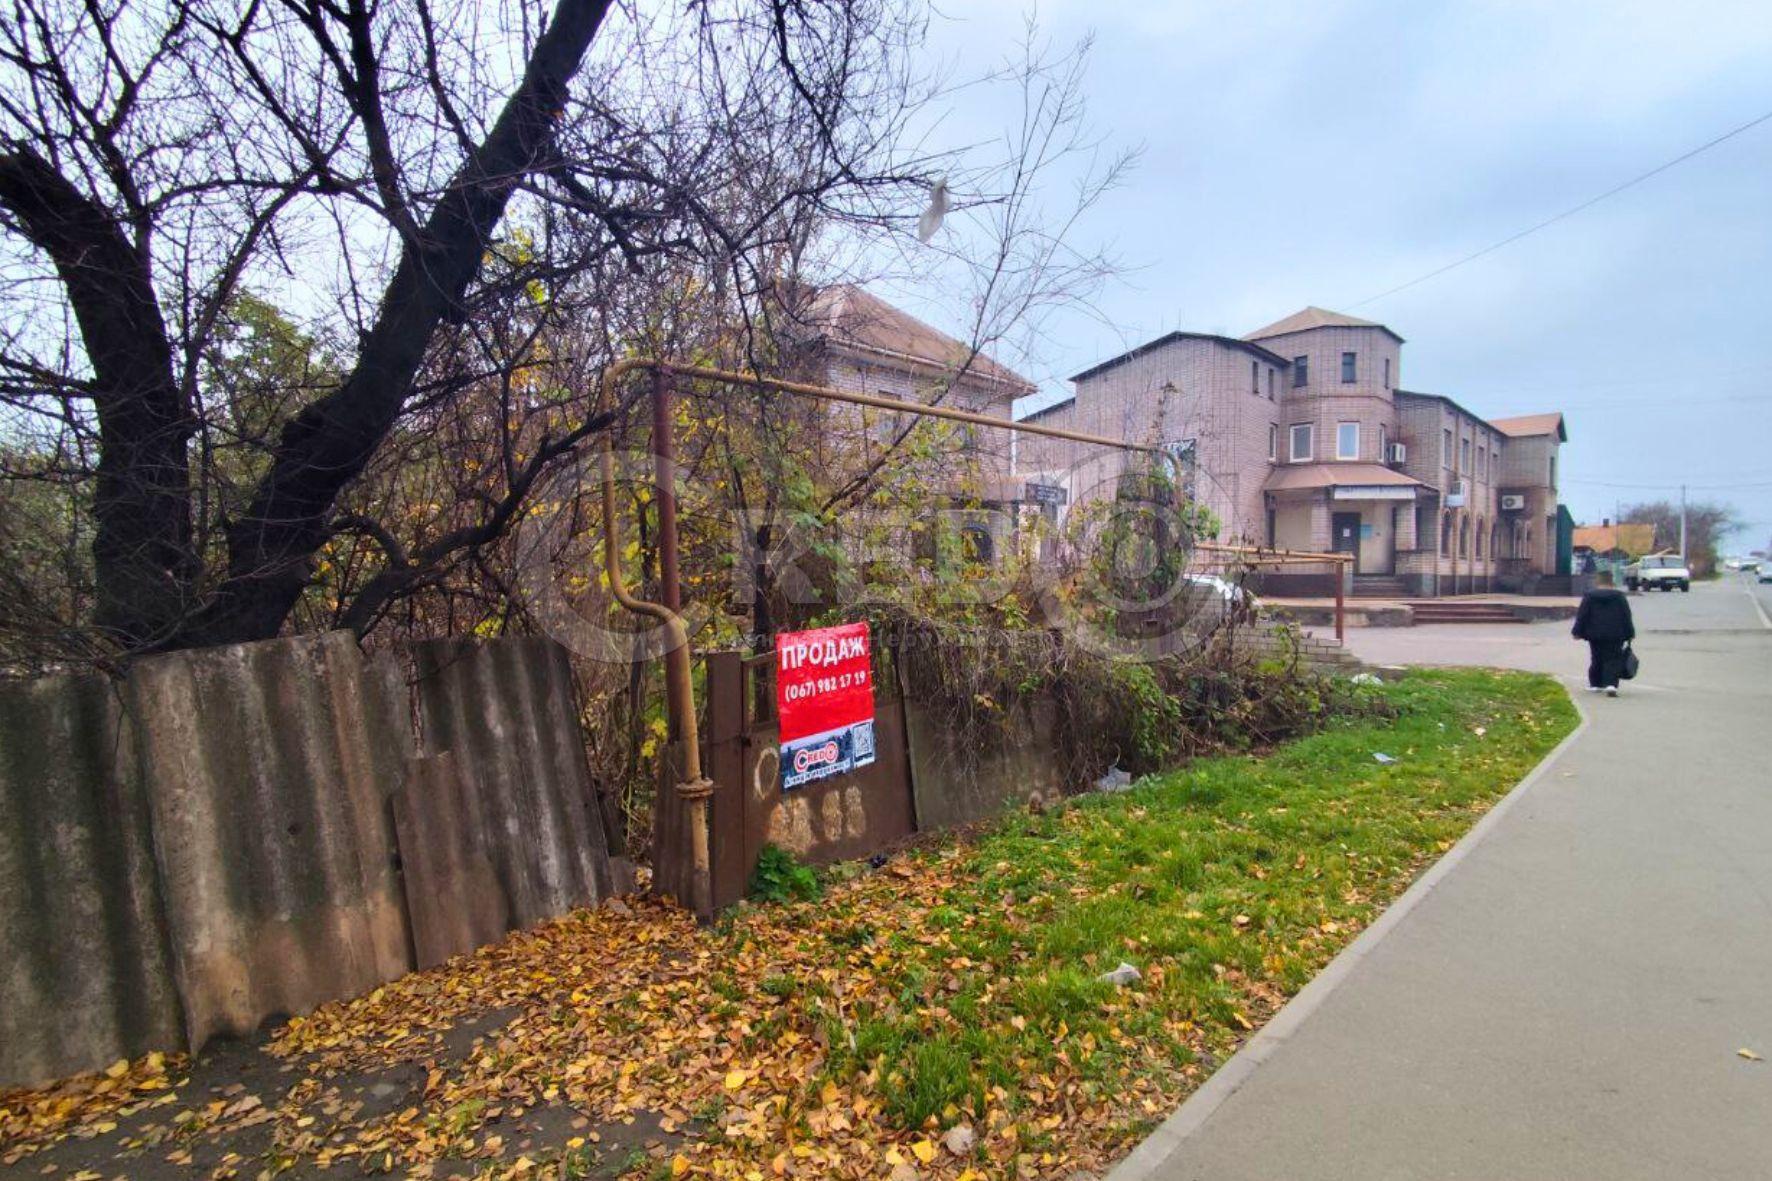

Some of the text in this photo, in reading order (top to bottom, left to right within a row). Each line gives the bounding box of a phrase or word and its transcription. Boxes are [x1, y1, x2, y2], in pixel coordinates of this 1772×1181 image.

[781, 636, 865, 670] ПРОДАЖ
[785, 670, 866, 703] (067) 982 17 19
